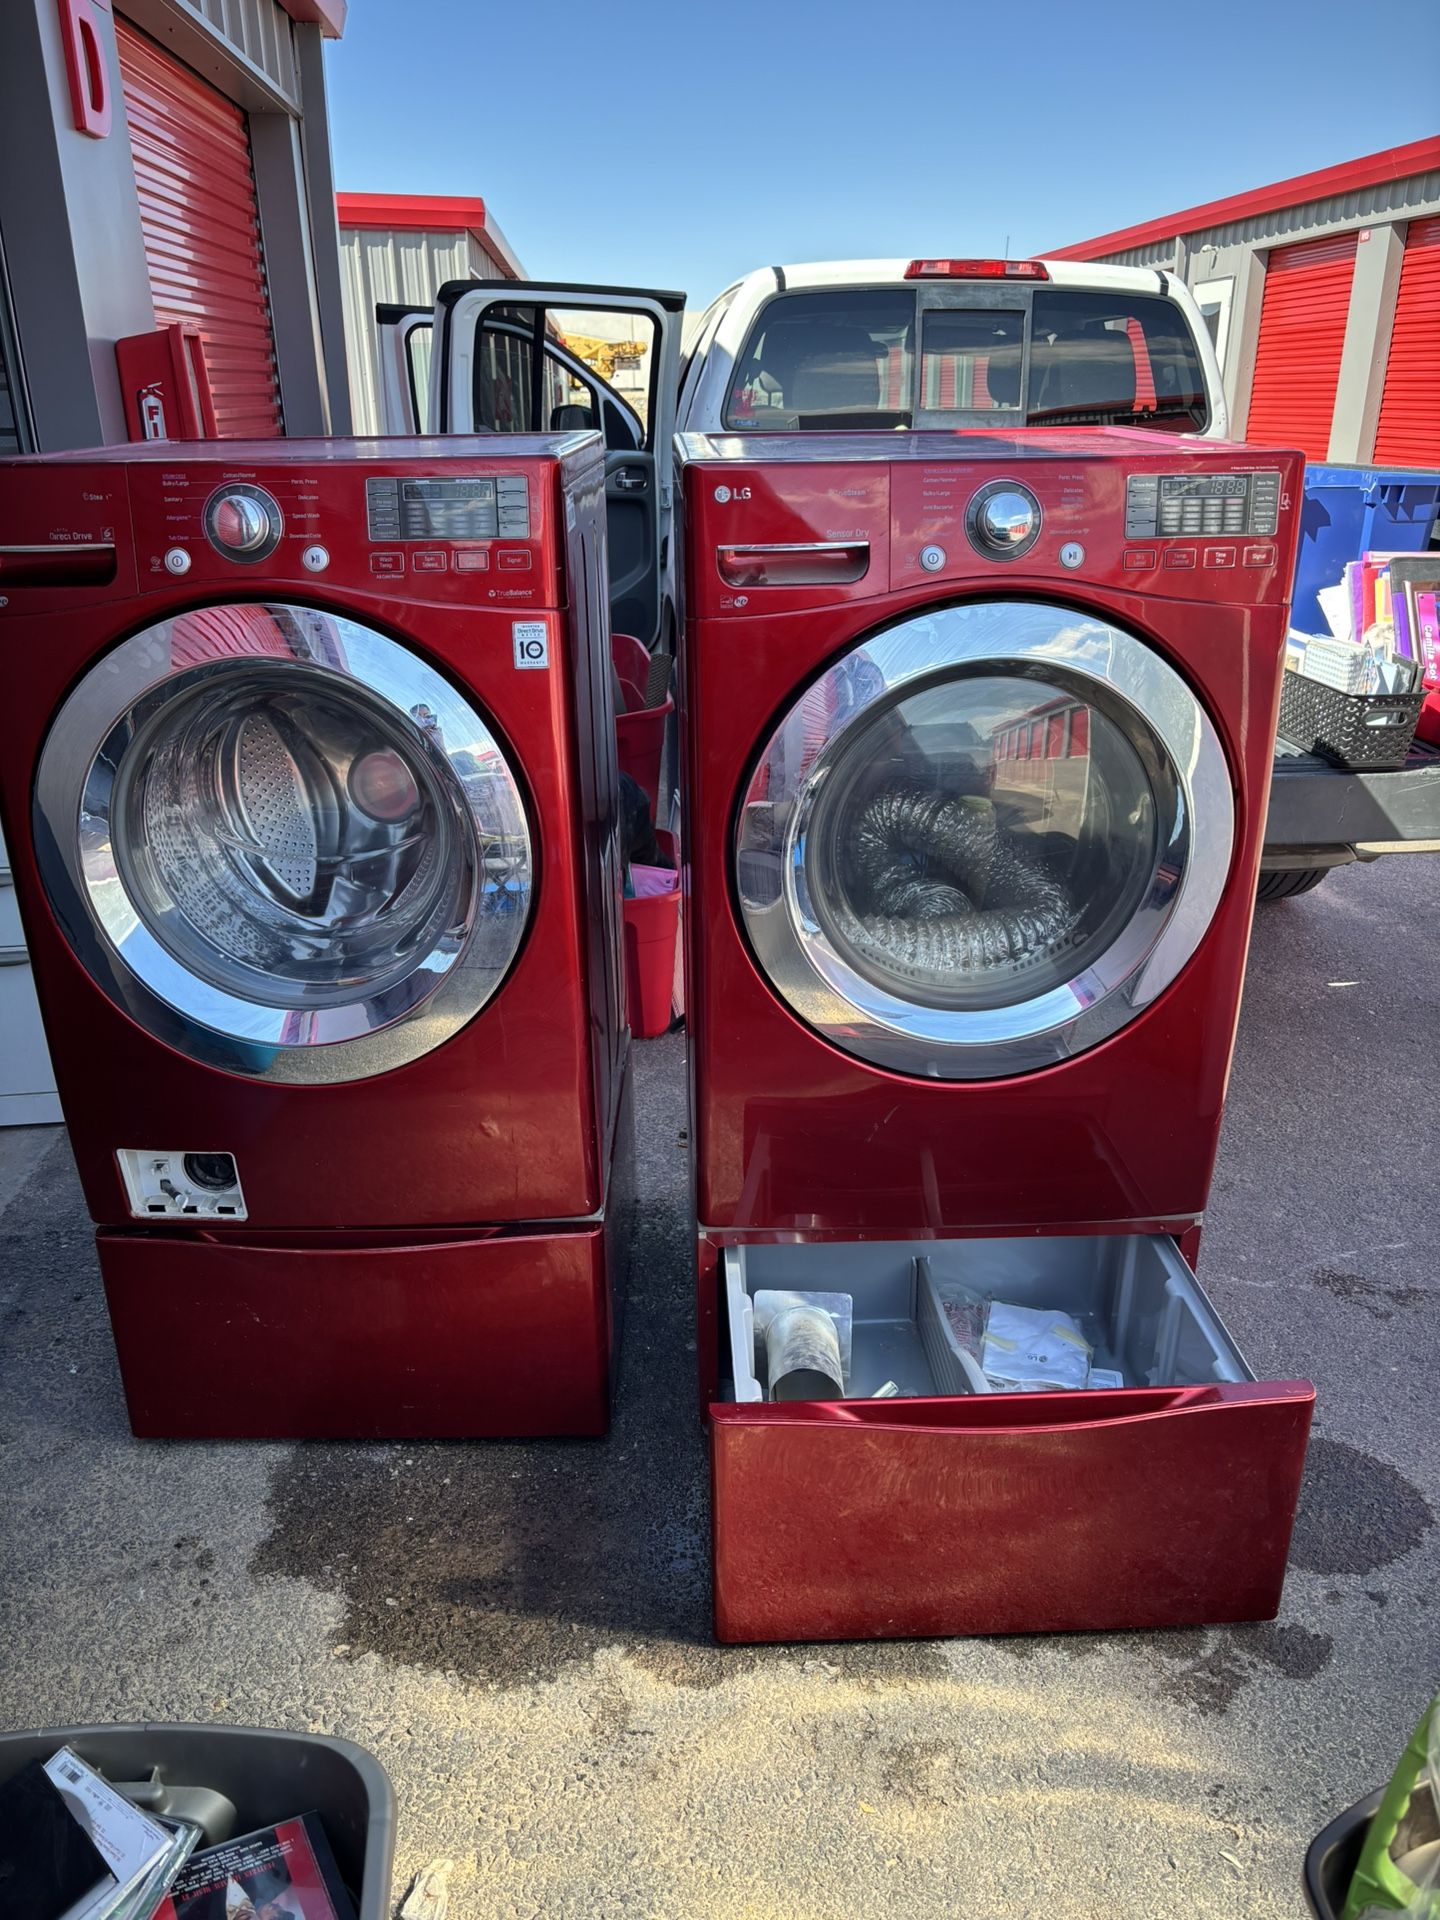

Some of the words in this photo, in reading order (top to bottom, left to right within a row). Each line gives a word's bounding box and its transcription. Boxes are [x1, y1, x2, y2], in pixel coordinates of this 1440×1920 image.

[733, 487, 752, 500] LG
[72, 532, 93, 541] Drive
[826, 529, 853, 538] Sensor
[855, 528, 870, 538] Dry
[519, 640, 544, 660] 10
